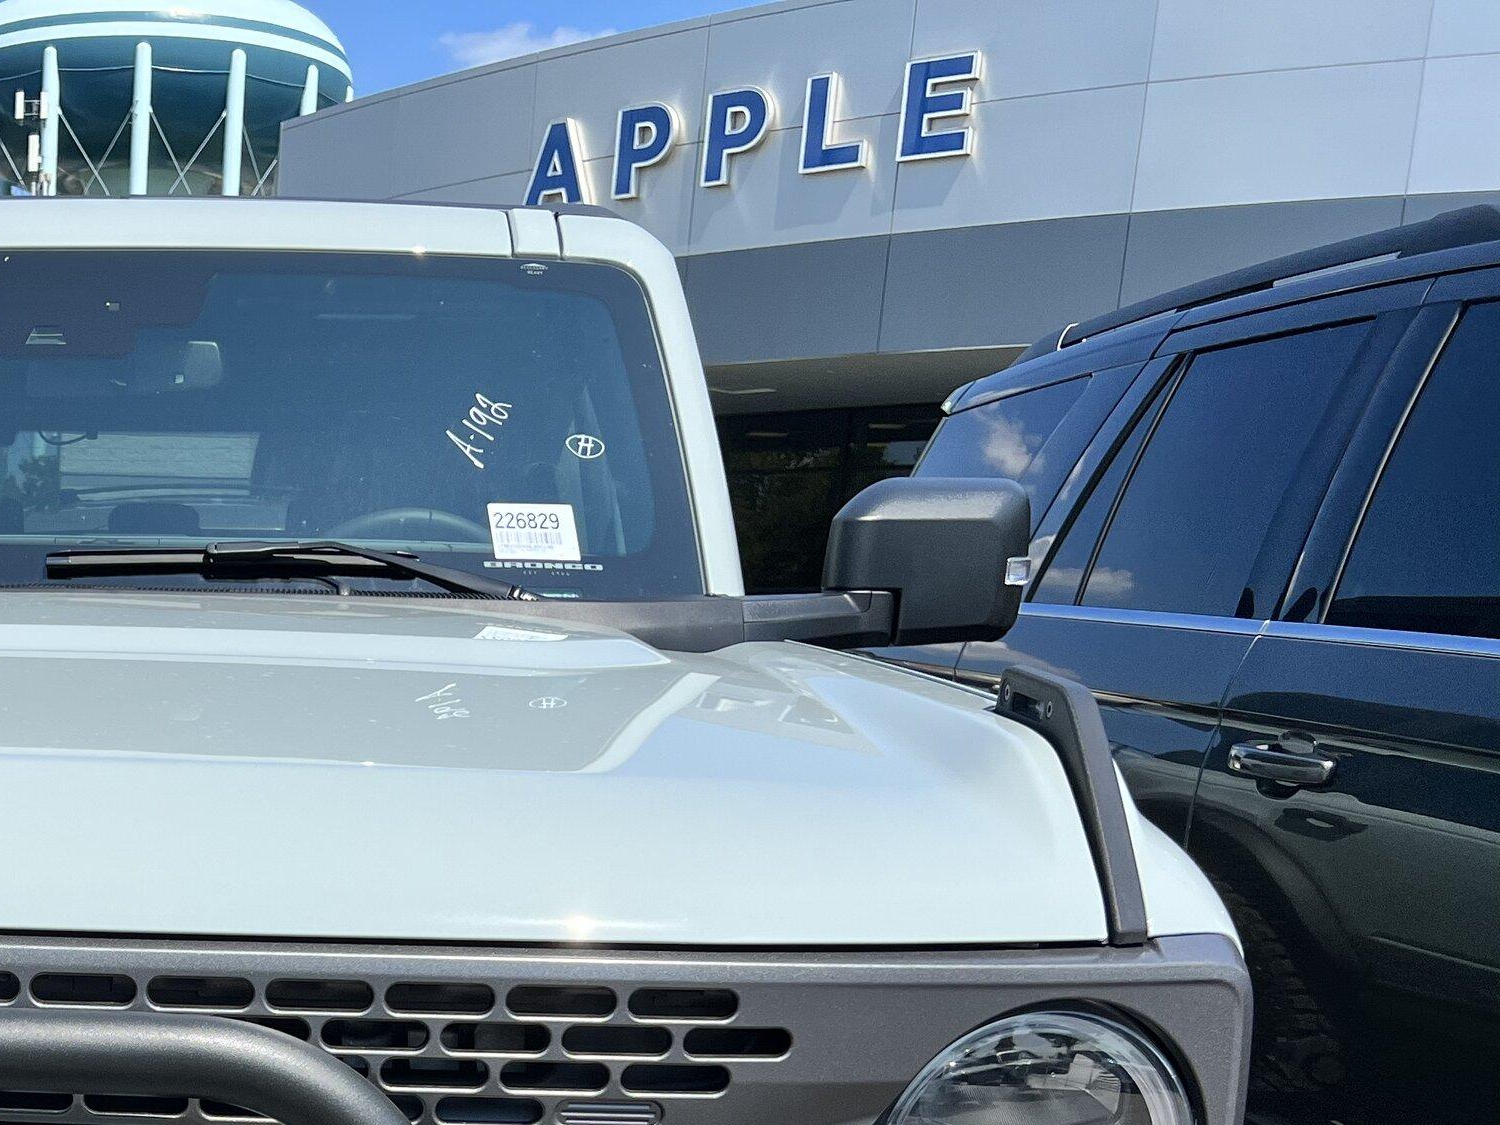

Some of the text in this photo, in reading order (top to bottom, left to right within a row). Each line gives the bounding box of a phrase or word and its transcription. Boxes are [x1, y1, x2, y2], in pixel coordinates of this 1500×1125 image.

[523, 49, 982, 205] APPLE
[493, 512, 560, 530] 226829
[483, 561, 604, 571] BRONCO
